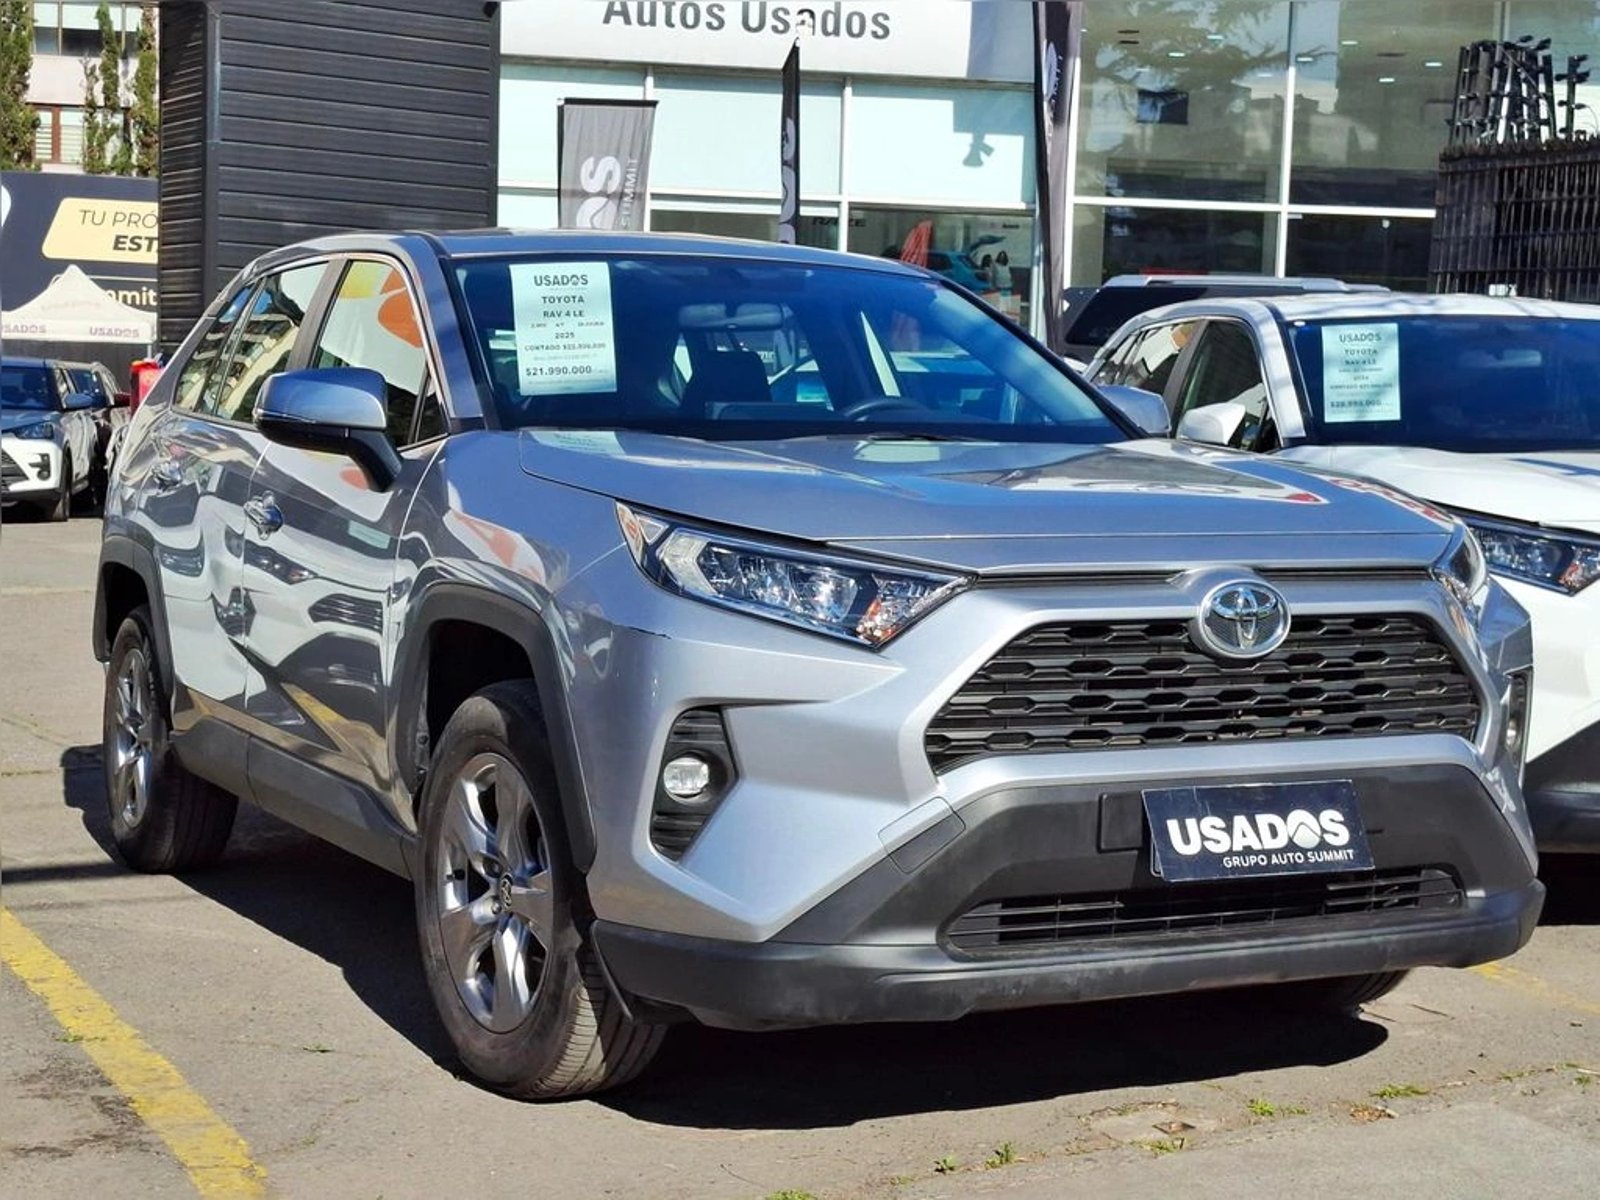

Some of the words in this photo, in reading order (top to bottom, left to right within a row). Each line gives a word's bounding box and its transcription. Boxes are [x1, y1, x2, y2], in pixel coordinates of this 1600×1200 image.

[602, 0, 726, 32] Autos
[741, 0, 891, 40] Usados
[79, 209, 106, 227] TU
[112, 234, 159, 253] EST
[533, 274, 589, 287] USADOS
[541, 295, 585, 304] TOYOTA
[543, 310, 562, 318] RAV
[573, 310, 585, 318] LE
[89, 326, 141, 338] USADOS
[1339, 332, 1382, 344] USADOS
[524, 344, 561, 352] CONTADO
[1344, 348, 1378, 356] TOYOTA
[525, 365, 592, 376] $21.990.000
[1166, 808, 1351, 856] USADOS
[1222, 853, 1267, 868] GRUPO
[1271, 852, 1304, 866] AUTO
[1307, 849, 1355, 862] SUMMIT
